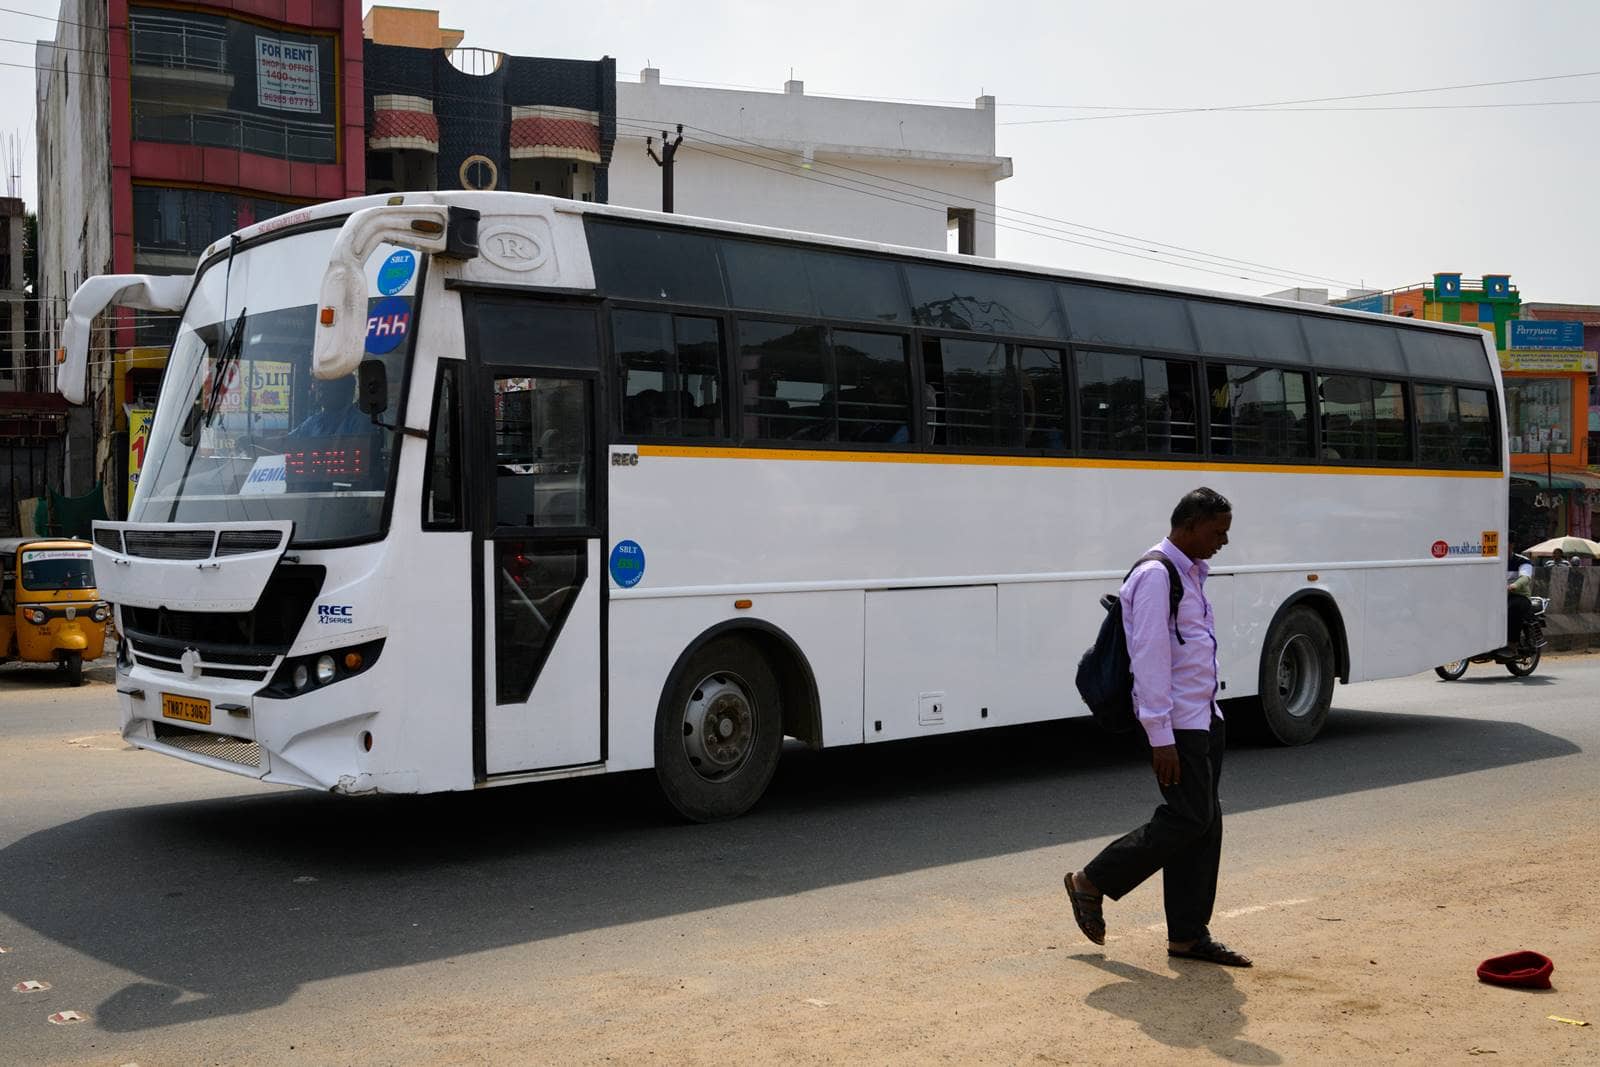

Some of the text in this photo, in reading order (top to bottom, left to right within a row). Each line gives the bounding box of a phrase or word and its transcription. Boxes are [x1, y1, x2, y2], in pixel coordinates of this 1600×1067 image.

[262, 43, 313, 61] FOR RENT
[266, 70, 288, 81] 1400
[496, 238, 529, 260] R
[1516, 325, 1558, 336] Parryware
[612, 452, 638, 466] REC
[619, 545, 638, 554] SBLT
[318, 605, 353, 616] REC
